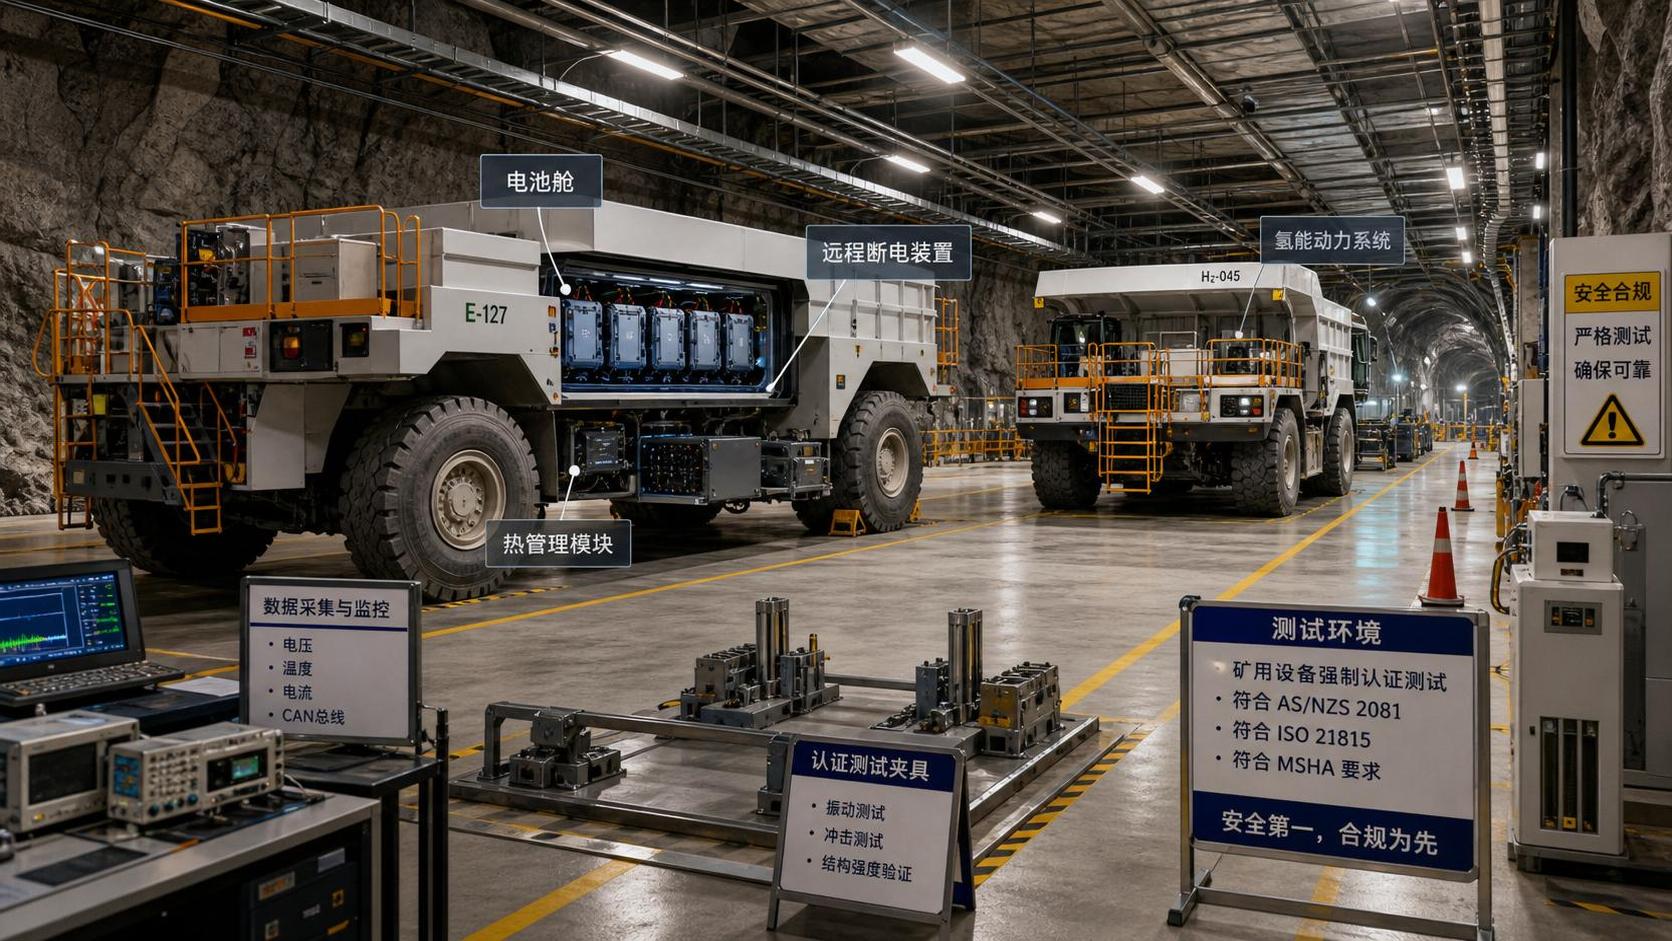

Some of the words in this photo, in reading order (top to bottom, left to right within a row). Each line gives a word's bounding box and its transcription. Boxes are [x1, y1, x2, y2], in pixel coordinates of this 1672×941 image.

[1574, 281, 1652, 303] 安全合规
[465, 302, 508, 325] E-127
[1574, 325, 1652, 347] 严格测试
[1574, 359, 1652, 380] 确保可靠
[263, 597, 391, 619] 数据采集与监控
[1271, 616, 1382, 645] 测试环境
[283, 636, 313, 653] 电压
[282, 660, 313, 677] 温度
[1232, 660, 1448, 693] 矿用设备强制认证测试
[283, 683, 313, 701] 电流
[1232, 690, 1272, 712] 符合
[1277, 695, 1350, 716] AS/NZS
[1356, 700, 1402, 720] 2081
[282, 708, 345, 726] CAN总线
[1232, 720, 1271, 742] 符合
[1277, 725, 1309, 743] ISO
[1315, 728, 1372, 748] 21815
[811, 750, 930, 782] 认证测试夹具
[1232, 750, 1271, 772] 符合
[1277, 755, 1335, 777] MSHA
[1341, 759, 1381, 781] 要求
[826, 799, 886, 822] 振动测试
[824, 827, 884, 850] 冲击测试
[821, 854, 913, 883] 结构强度验证
